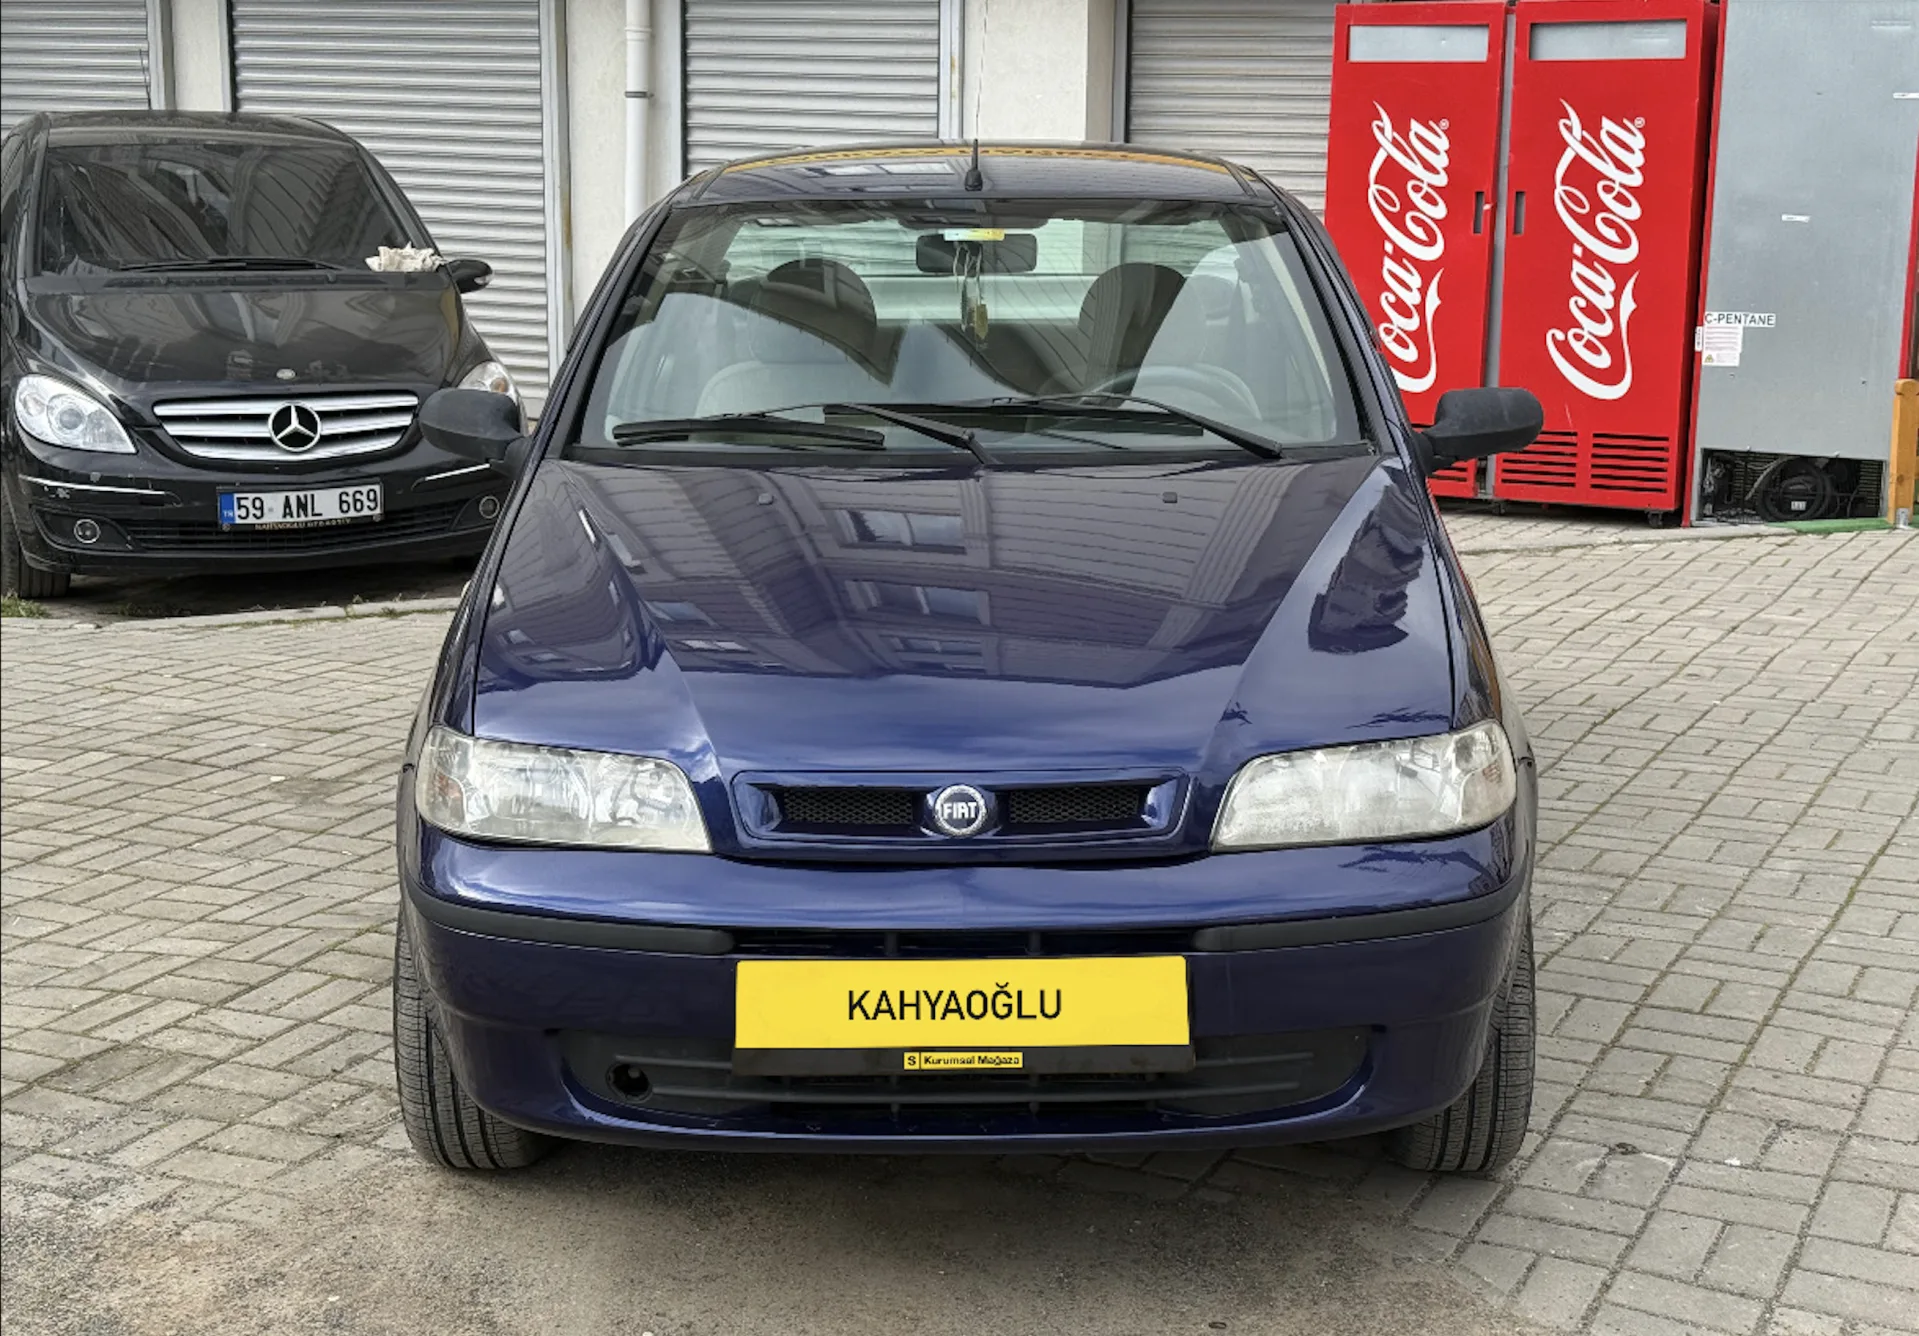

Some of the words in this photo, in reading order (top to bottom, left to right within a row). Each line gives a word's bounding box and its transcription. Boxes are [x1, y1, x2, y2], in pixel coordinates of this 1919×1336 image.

[1546, 97, 1645, 400] Coca-Cola
[1704, 313, 1775, 326] C-PENTANE
[235, 497, 264, 520] 59
[282, 494, 323, 519] ANL
[338, 488, 379, 514] 669
[943, 802, 977, 819] FIAT
[848, 982, 1062, 1020] KAHYAOĞLU
[907, 1056, 917, 1066] S
[924, 1056, 976, 1065] Kurumsal
[978, 1056, 1020, 1067] Mağaza
